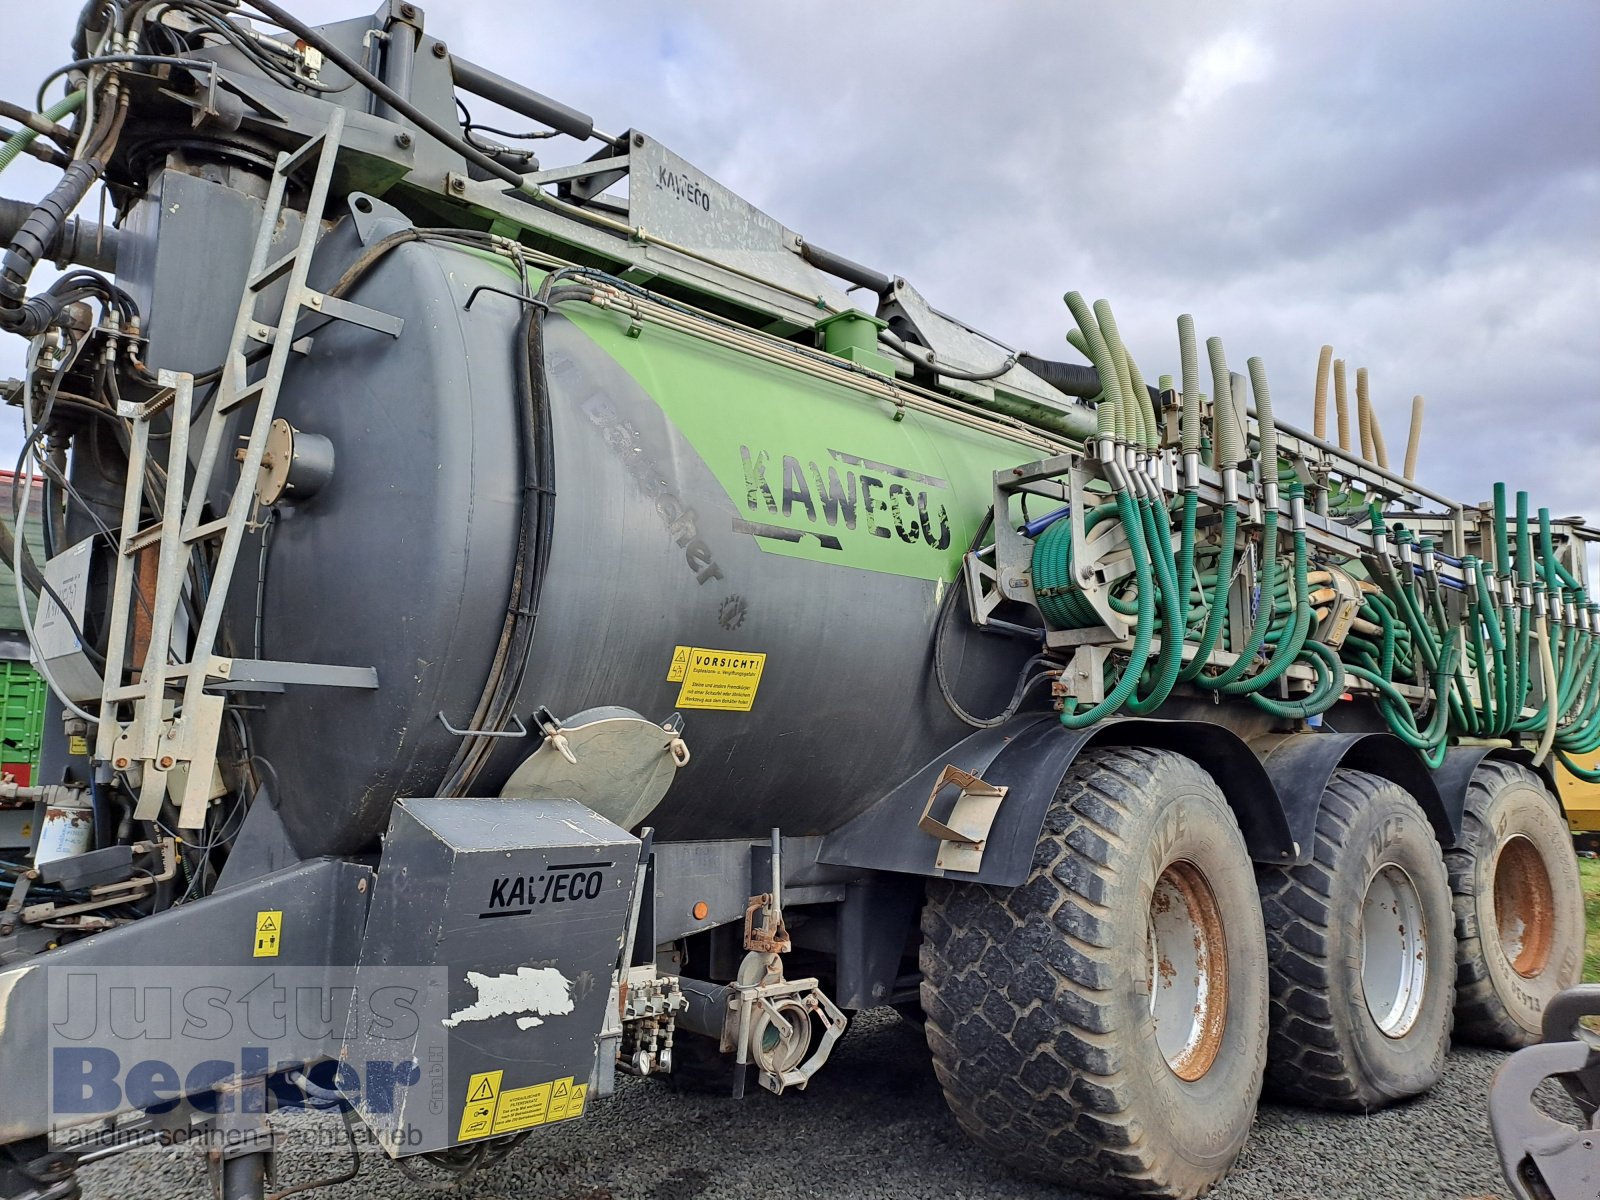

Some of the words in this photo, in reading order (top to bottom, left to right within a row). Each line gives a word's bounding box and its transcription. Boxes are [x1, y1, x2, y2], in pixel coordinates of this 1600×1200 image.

[659, 165, 710, 212] KAWECO
[740, 445, 951, 551] KAWECO
[696, 655, 760, 669] VORSICHT!
[488, 870, 603, 909] KAWECO
